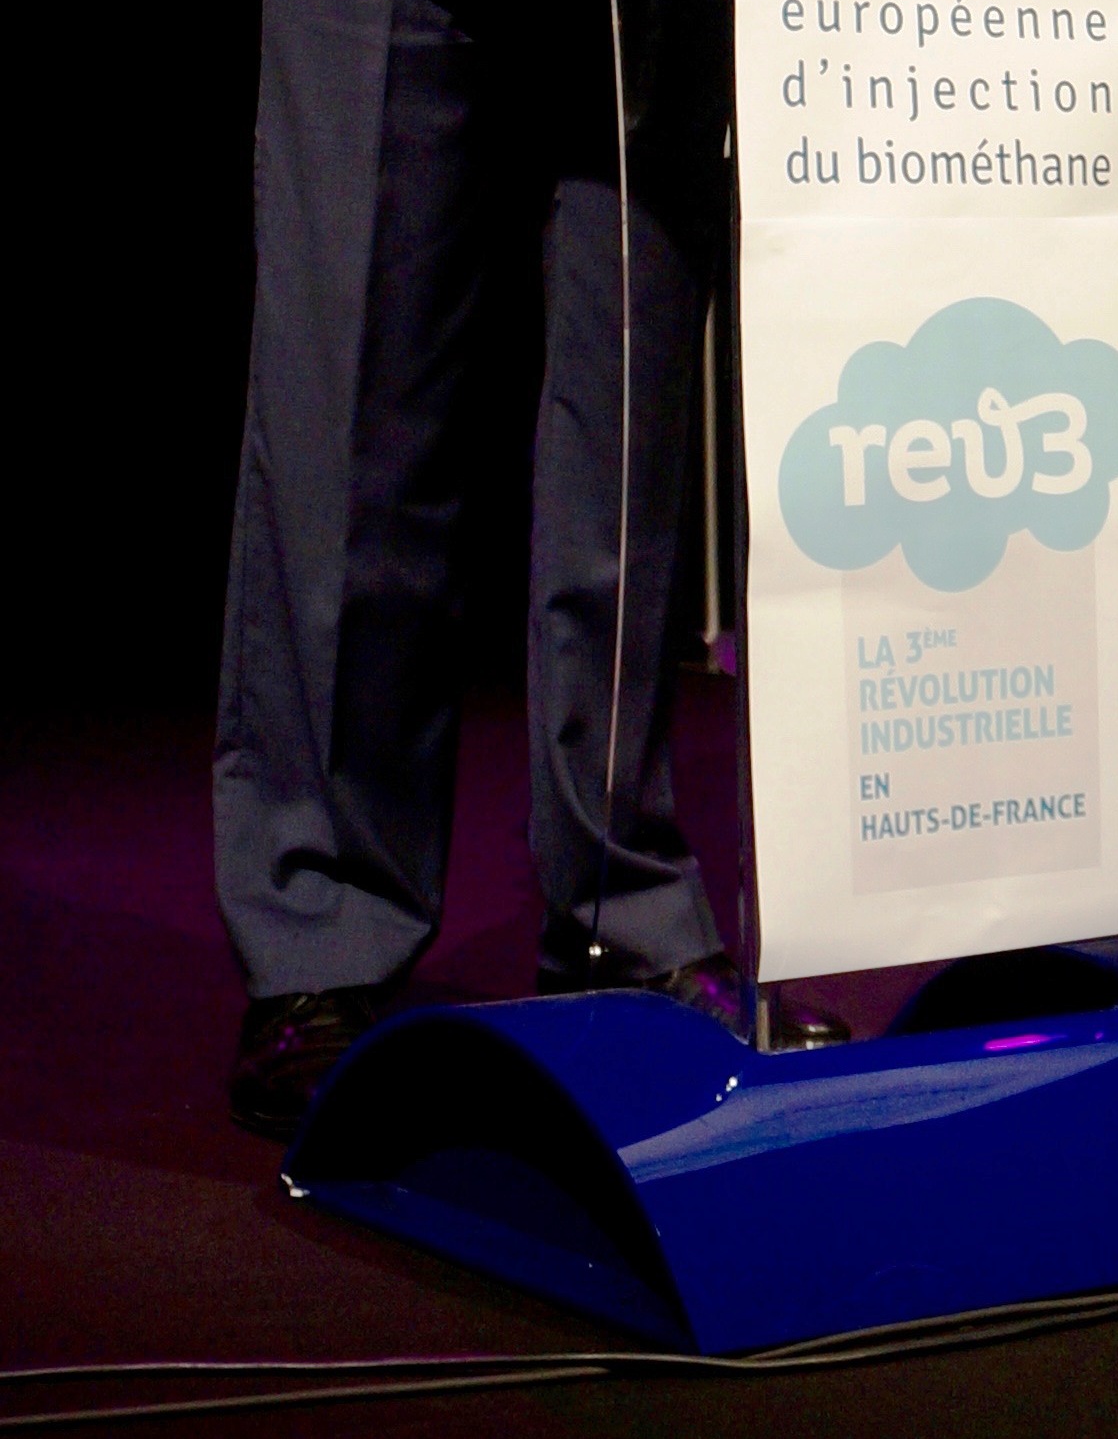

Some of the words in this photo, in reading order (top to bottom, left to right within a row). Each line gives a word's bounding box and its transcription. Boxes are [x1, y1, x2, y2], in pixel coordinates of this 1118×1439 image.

[786, 135, 840, 184] du
[857, 136, 1111, 187] biométhane
[828, 386, 1094, 508] rev3
[857, 635, 896, 669] LA
[859, 664, 1055, 712] RÉVOLUTION
[861, 704, 1073, 756] INDUSTRIELLE
[860, 772, 891, 801] EN
[861, 792, 1087, 842] HAUTS-DE-FRANCE
